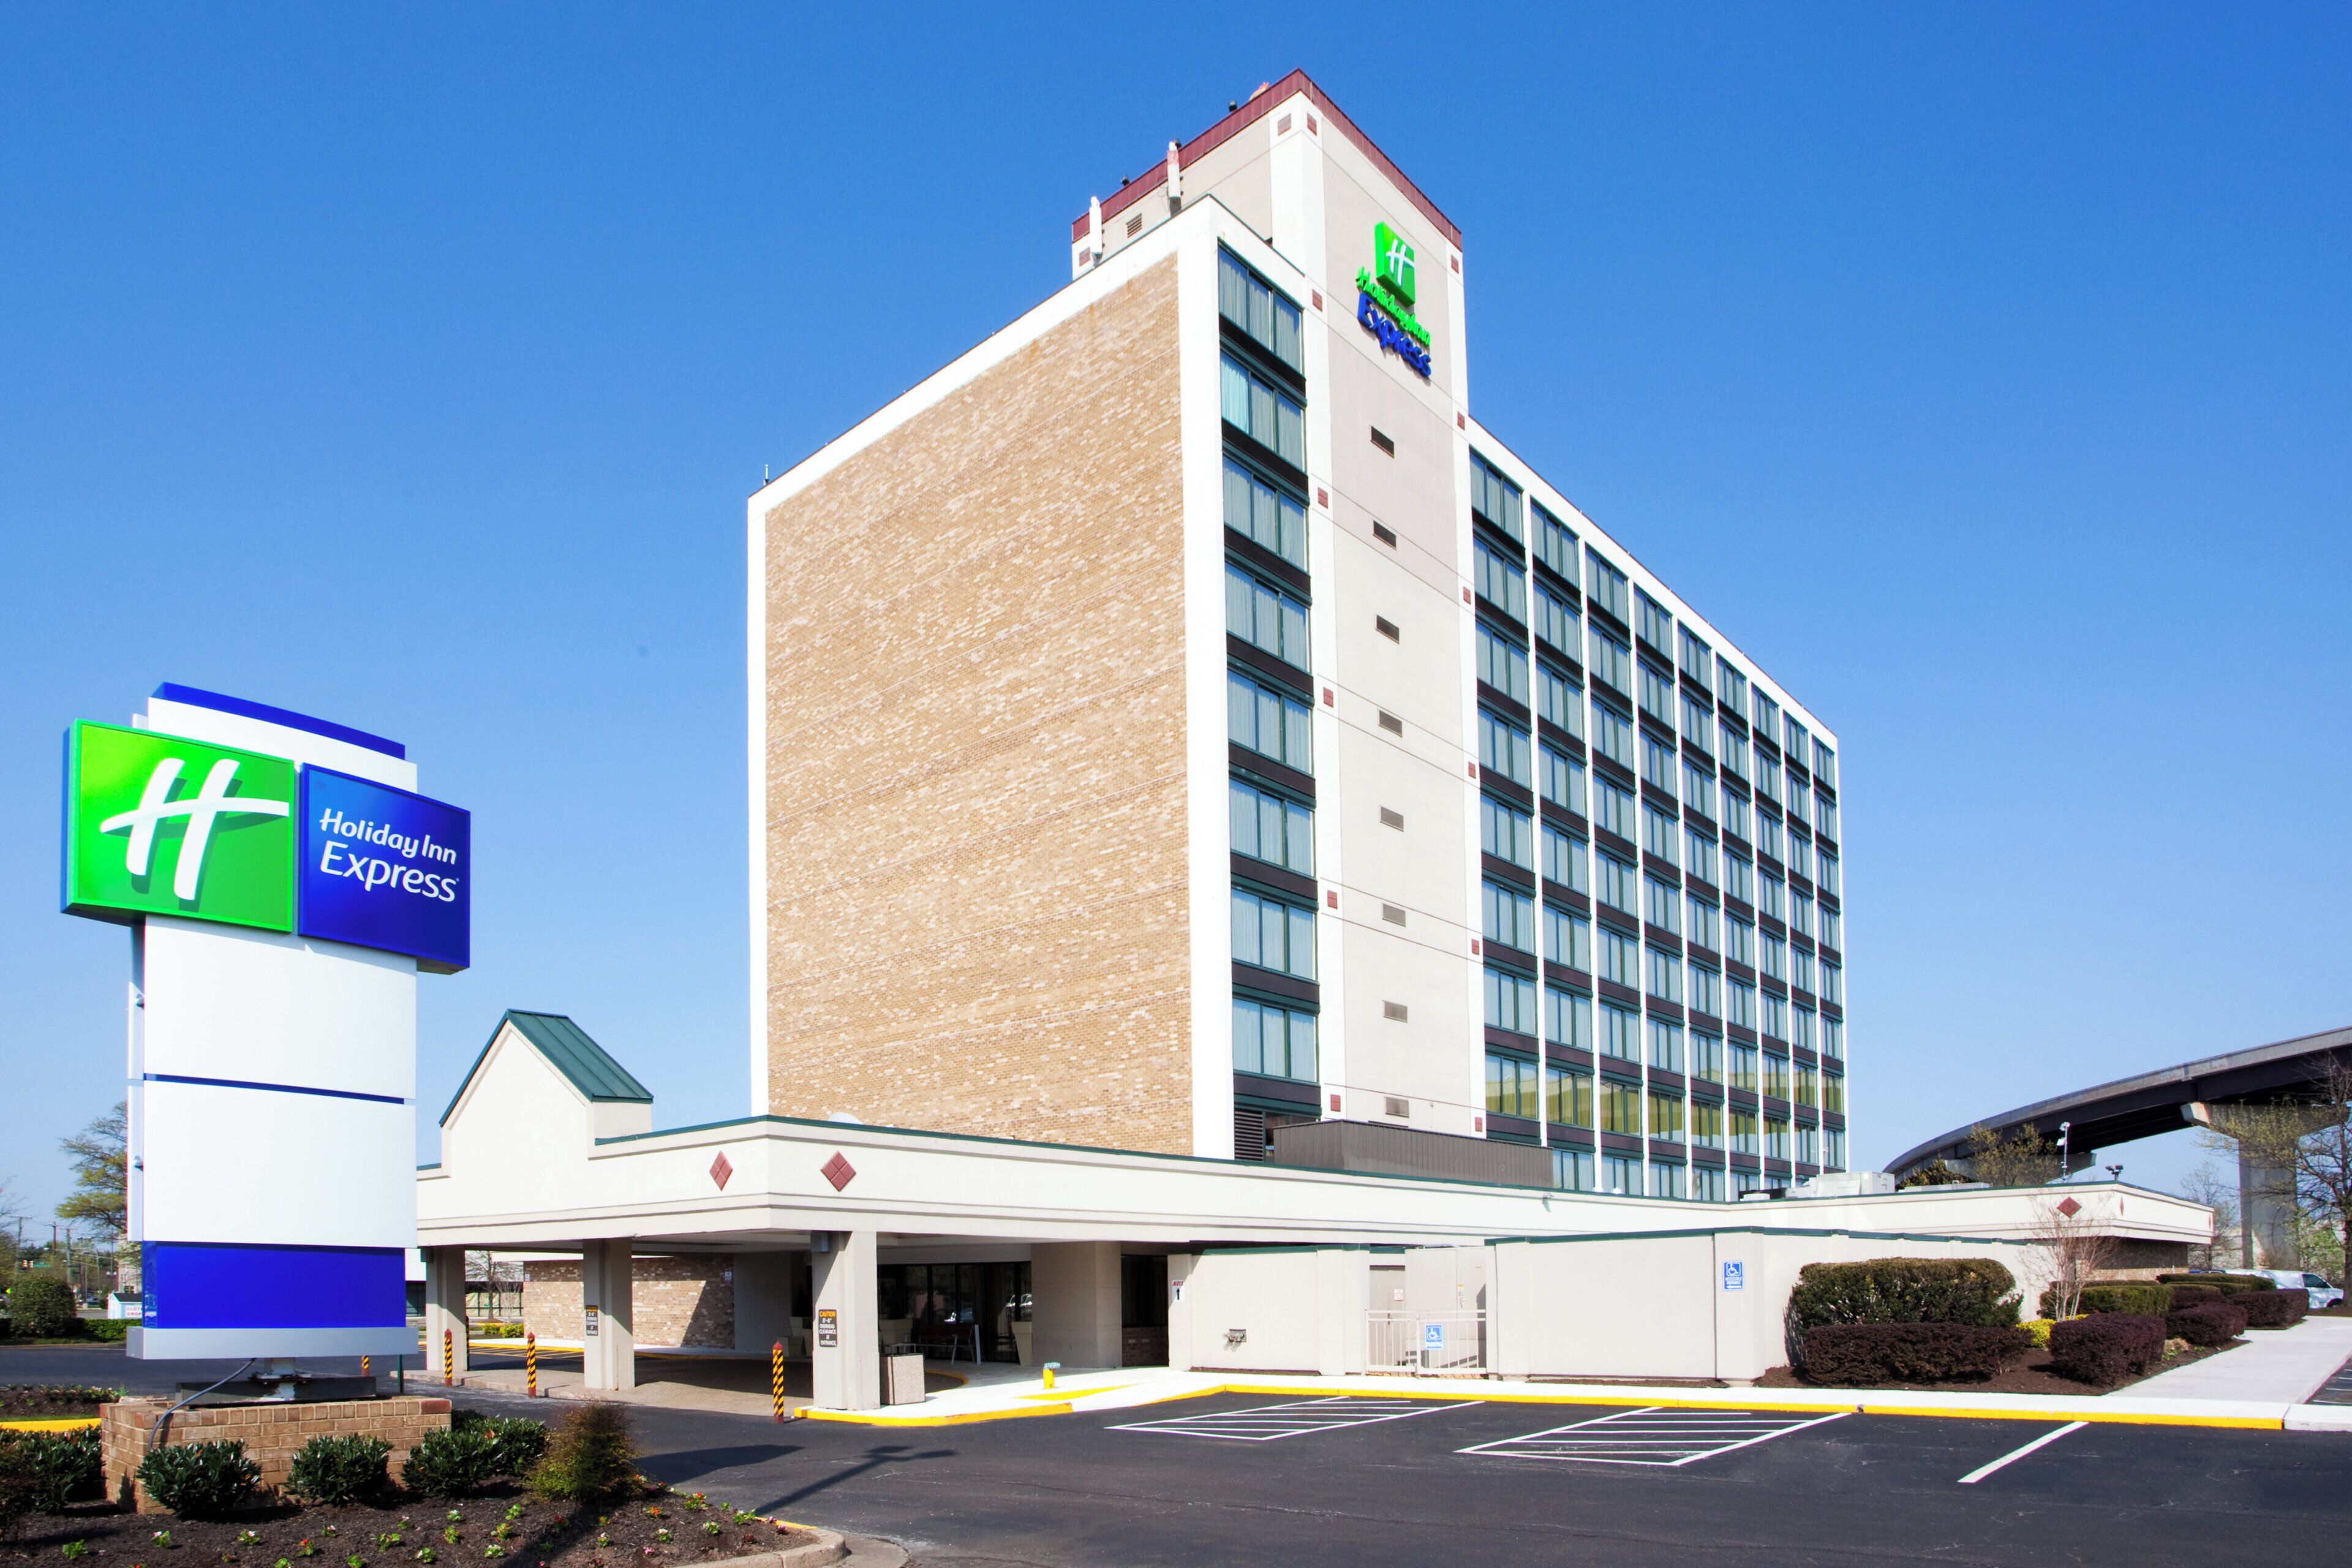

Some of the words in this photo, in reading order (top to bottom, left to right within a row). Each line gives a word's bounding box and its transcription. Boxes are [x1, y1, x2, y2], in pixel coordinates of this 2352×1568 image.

[1355, 266, 1410, 331] Holiday
[1357, 292, 1432, 377] Express
[319, 807, 420, 859] Holiday
[421, 834, 457, 865] Inn
[320, 840, 456, 902] Express
